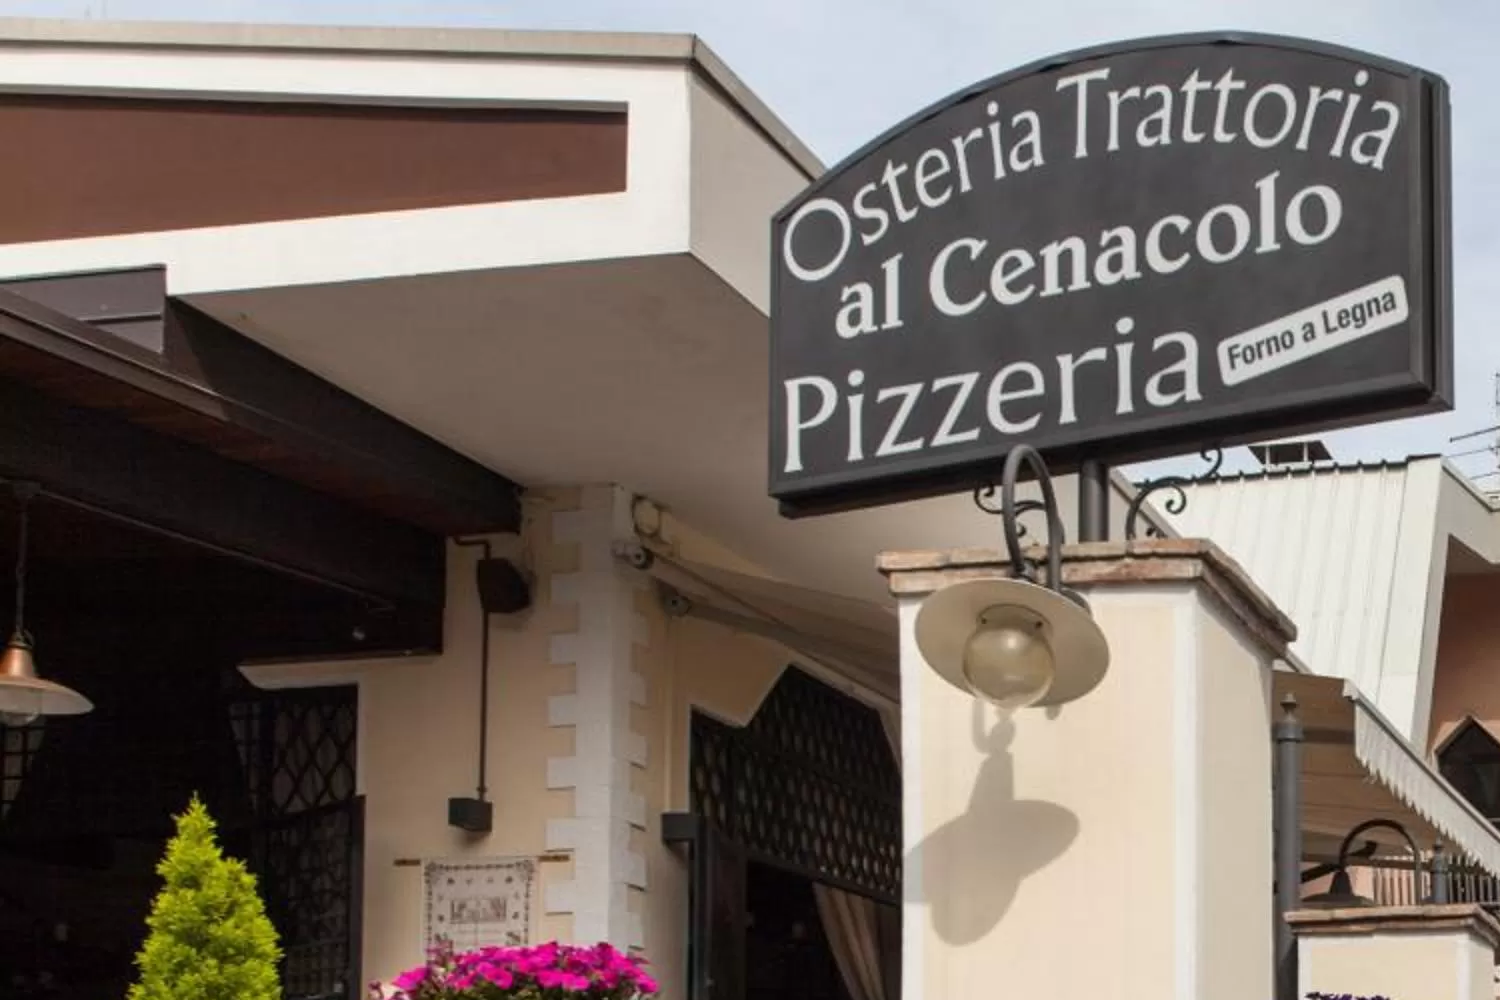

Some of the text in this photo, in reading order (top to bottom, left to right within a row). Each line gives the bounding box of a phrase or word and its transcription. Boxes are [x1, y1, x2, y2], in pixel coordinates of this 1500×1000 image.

[783, 67, 1401, 282] Osteria Trattoria
[835, 171, 1342, 339] al Cenacolo
[783, 318, 1203, 473] Pizzeria
[1227, 289, 1397, 371] Forno a Legna
